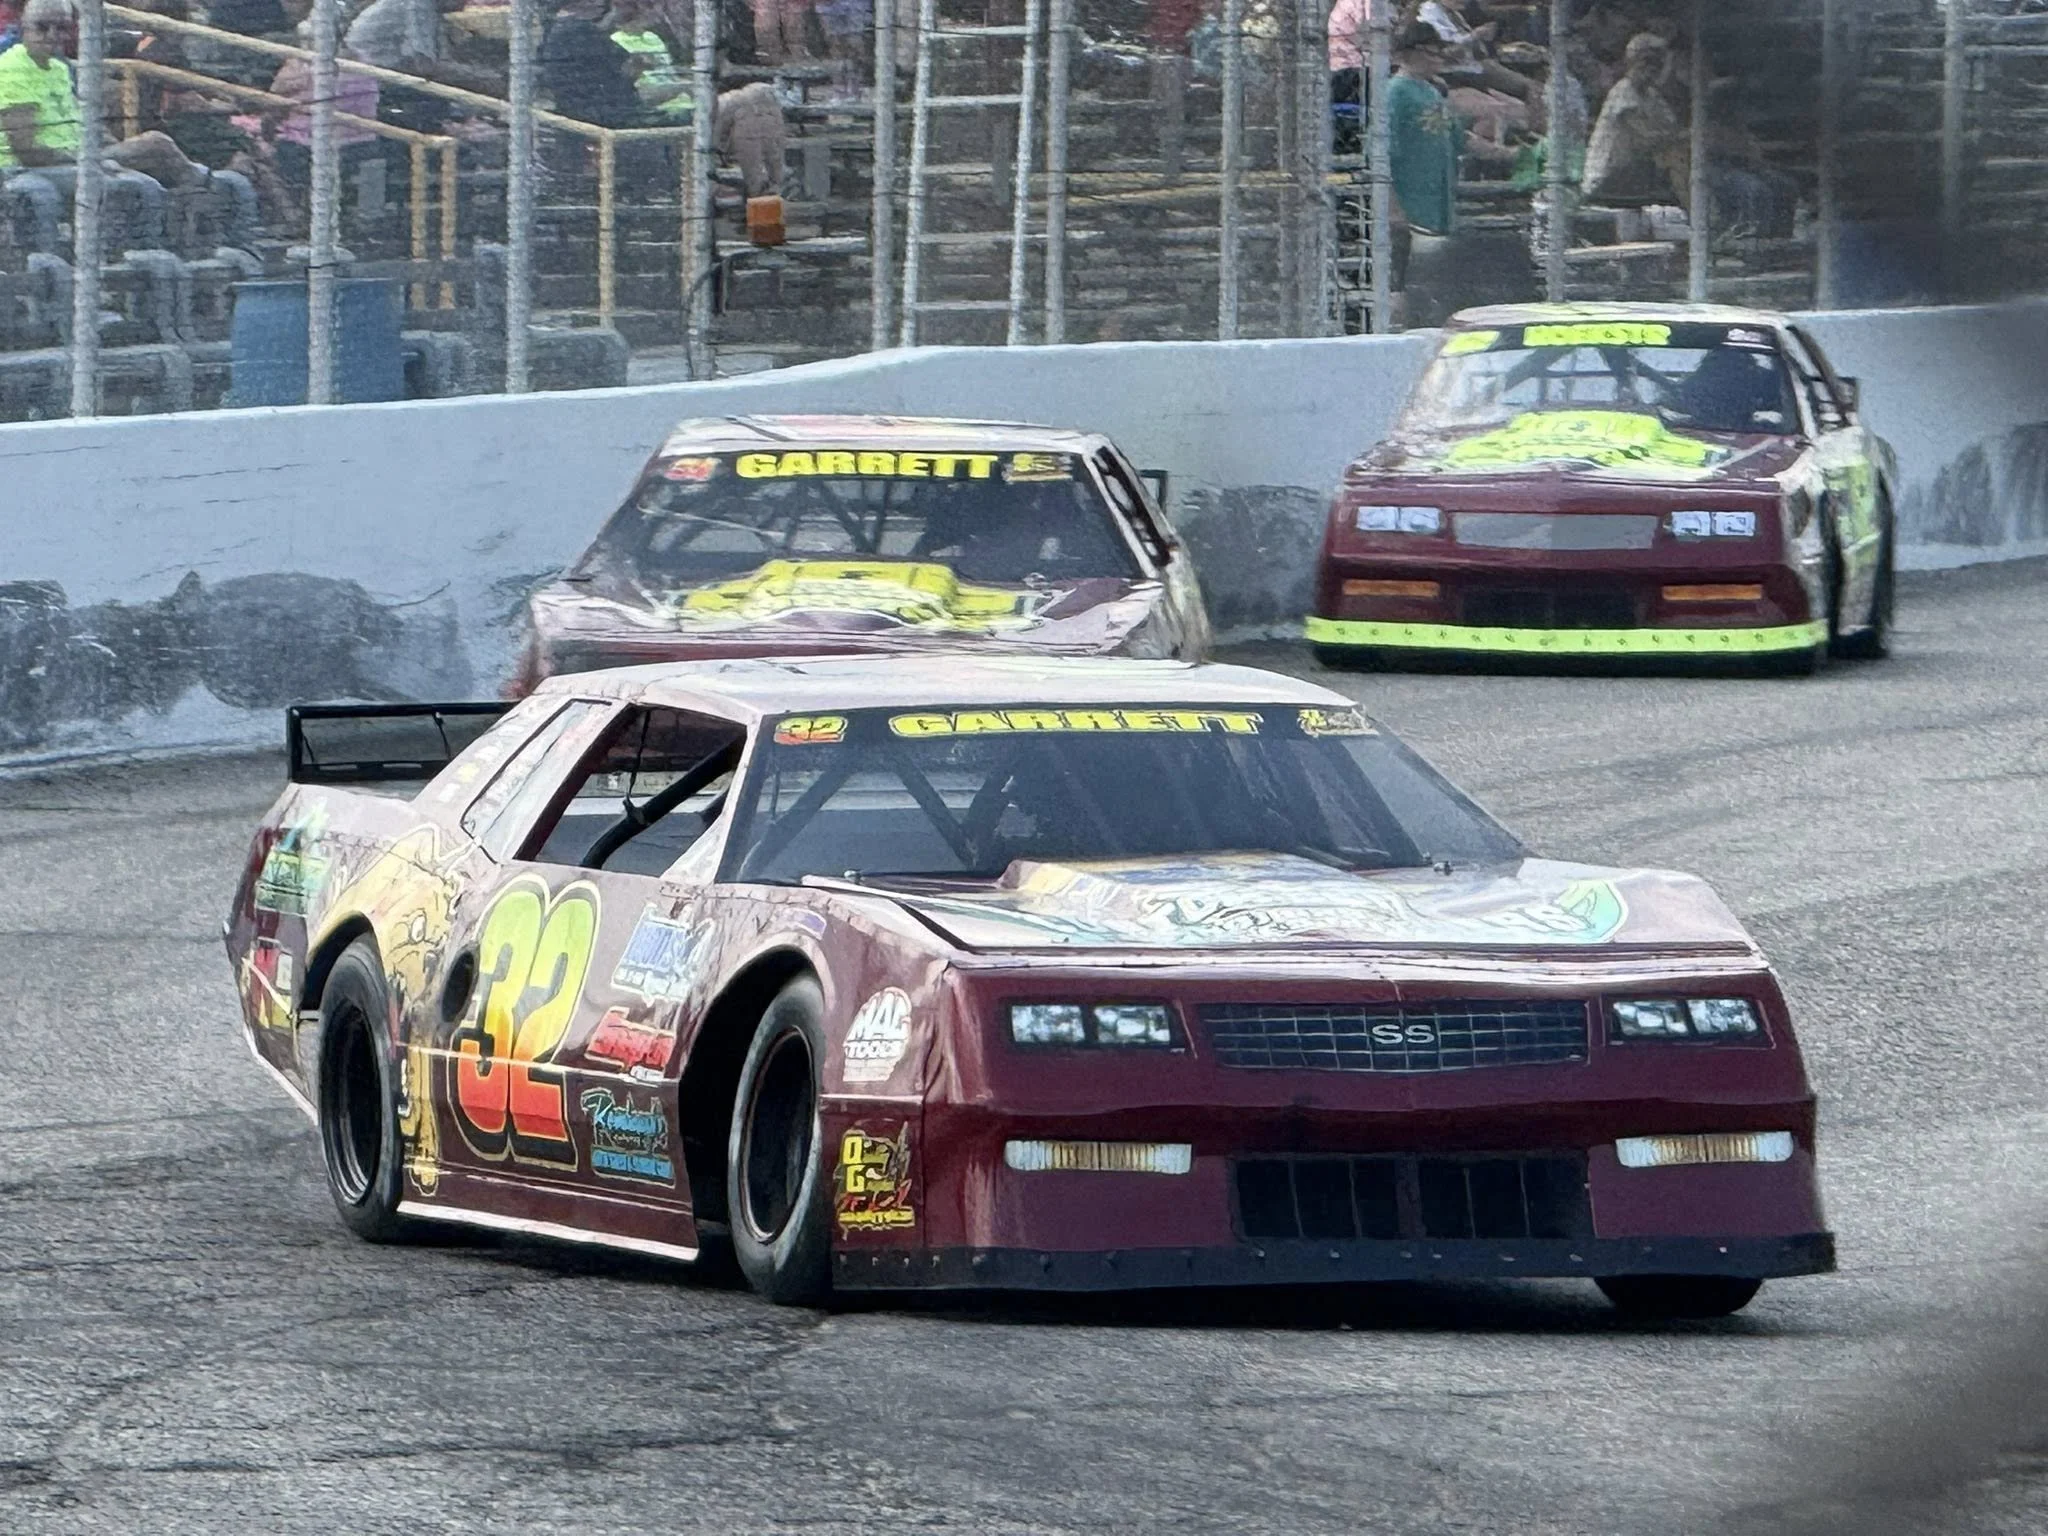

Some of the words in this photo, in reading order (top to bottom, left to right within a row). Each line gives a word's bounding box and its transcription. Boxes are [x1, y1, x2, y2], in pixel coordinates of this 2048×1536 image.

[736, 451, 999, 479] GARRETT
[774, 715, 847, 745] 32
[888, 708, 1264, 738] GARRETT
[451, 876, 599, 1164] 32
[847, 988, 911, 1040] MAC
[1371, 1024, 1434, 1045] SS
